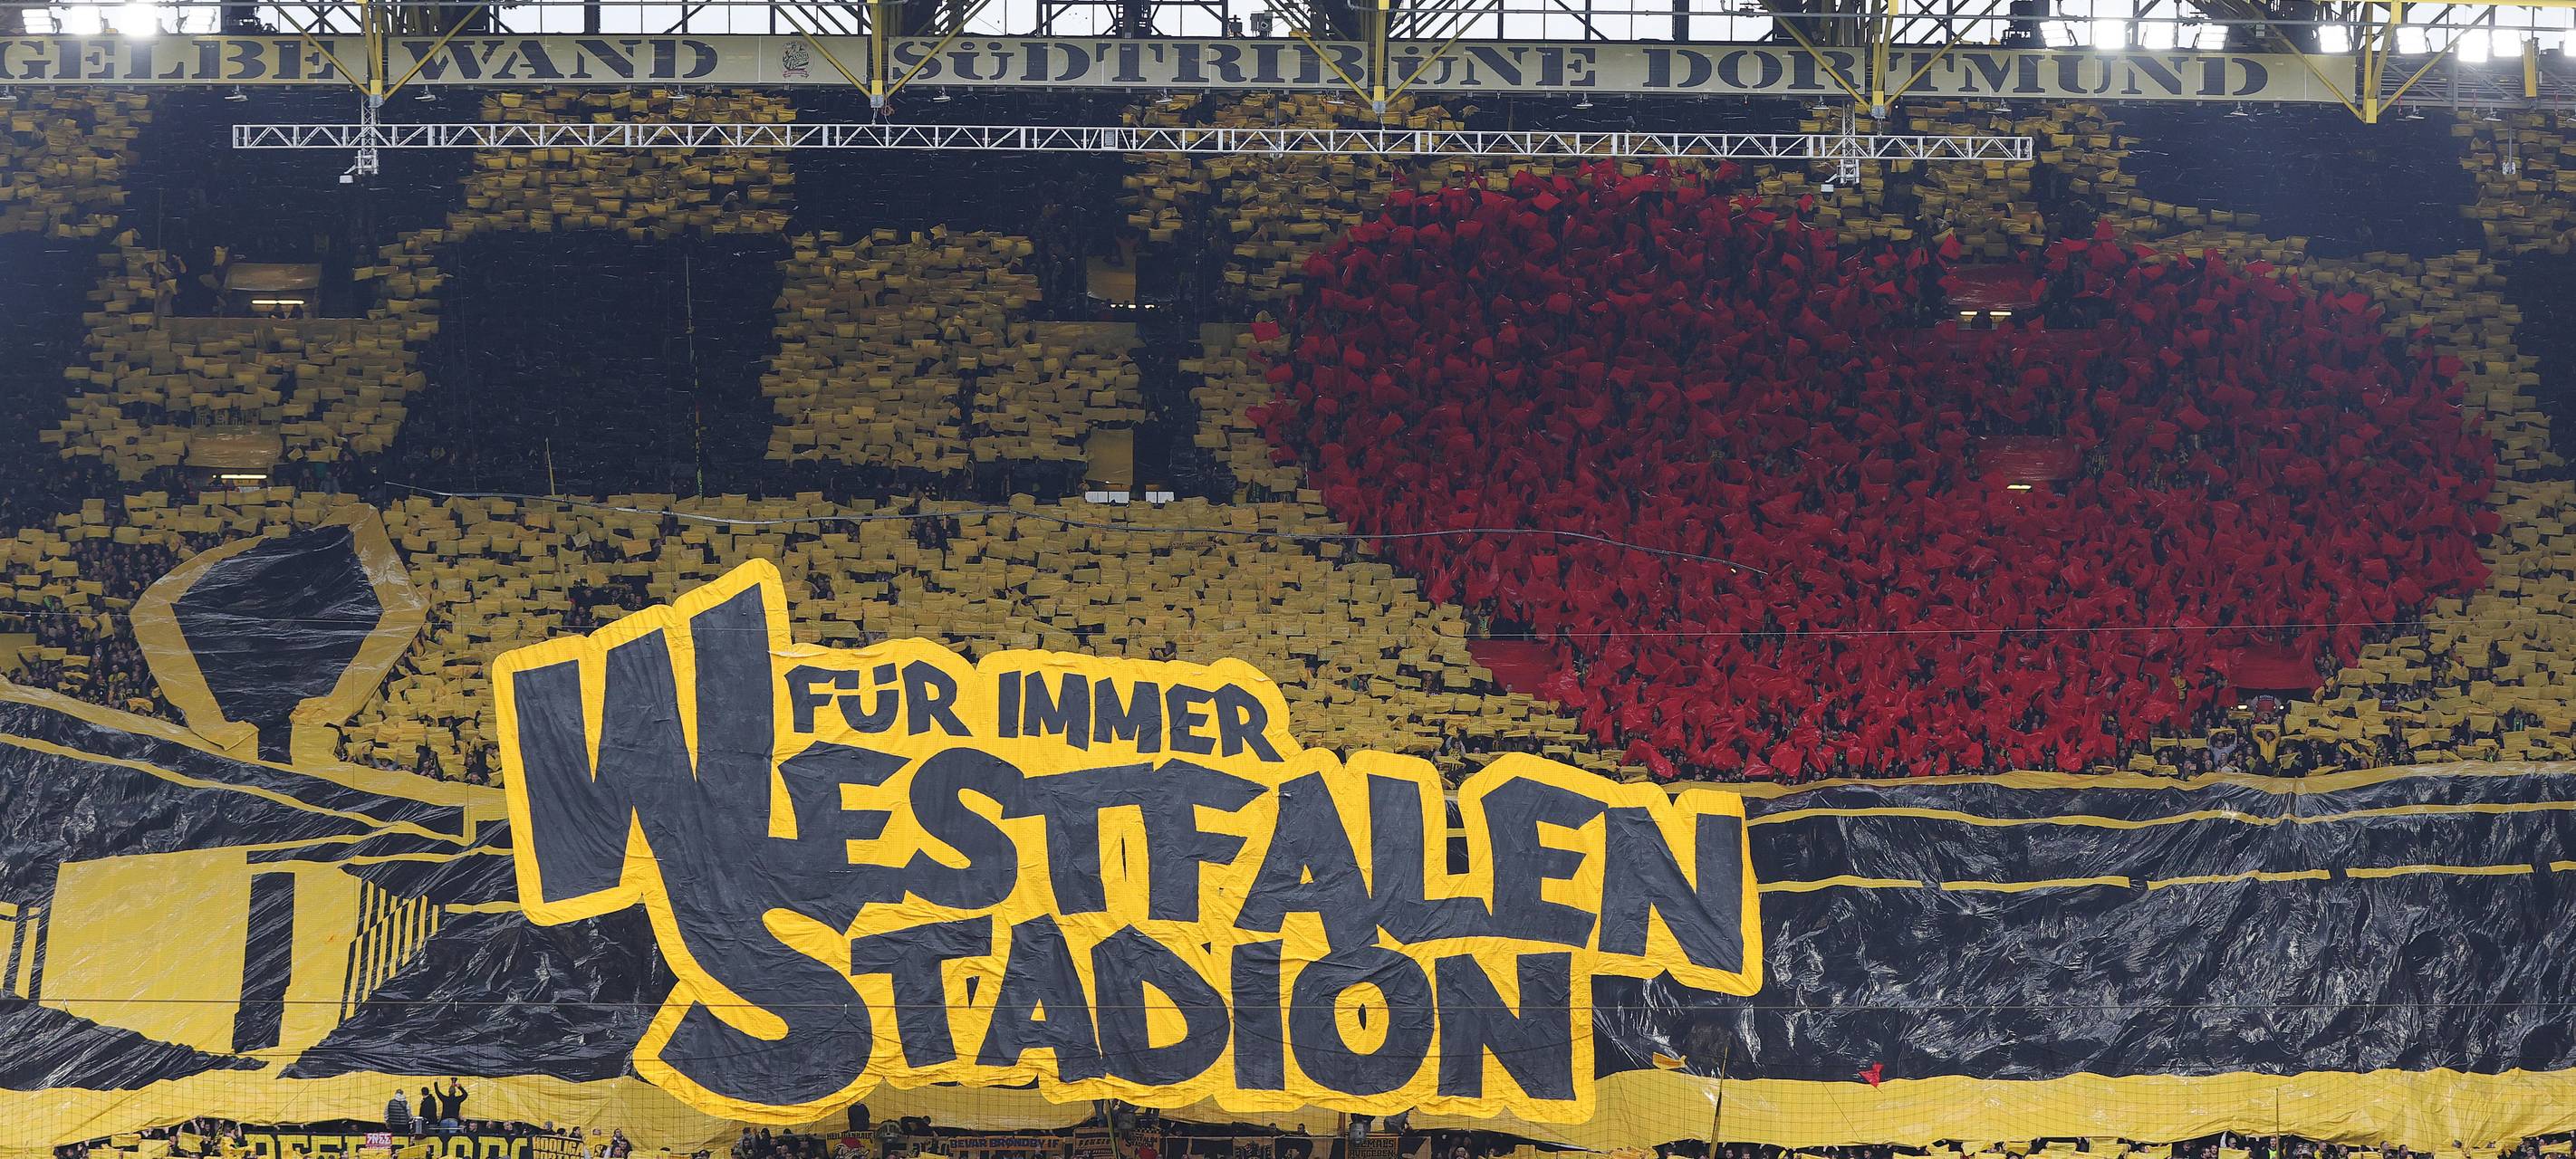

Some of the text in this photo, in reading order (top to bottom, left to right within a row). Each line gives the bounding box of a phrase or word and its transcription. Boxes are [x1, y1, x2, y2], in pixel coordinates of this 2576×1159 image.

[0, 40, 718, 80] GELBE WAND
[1642, 48, 2268, 96] DORTMUND
[784, 659, 1285, 762] FÜR IMMER
[513, 582, 1745, 974] WESTFALEN
[658, 913, 1575, 1105] STADION
[366, 1133, 391, 1145] FREE
[951, 1138, 986, 1148] BEVAR
